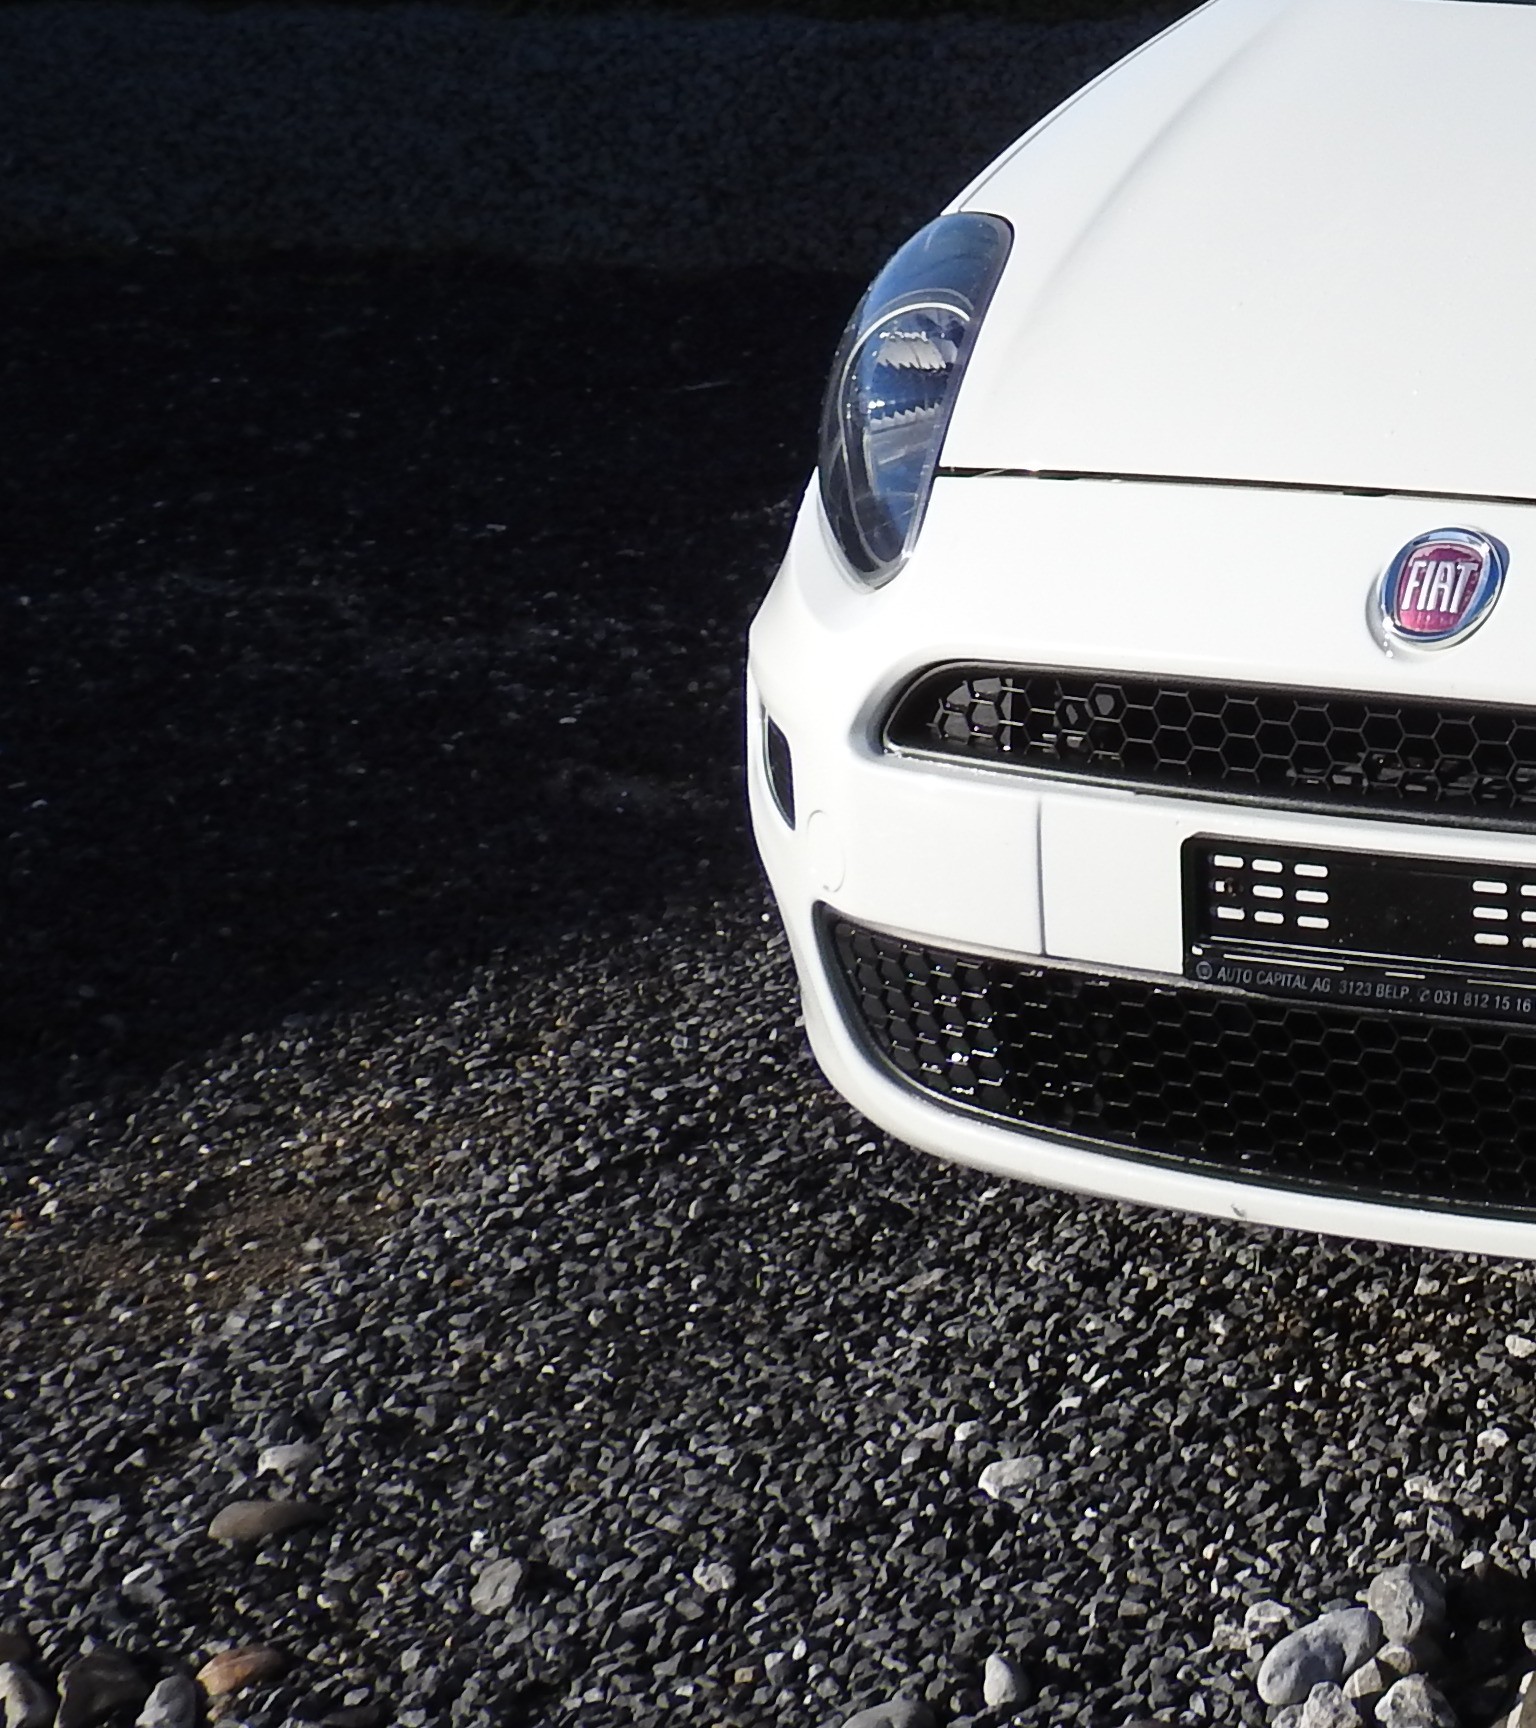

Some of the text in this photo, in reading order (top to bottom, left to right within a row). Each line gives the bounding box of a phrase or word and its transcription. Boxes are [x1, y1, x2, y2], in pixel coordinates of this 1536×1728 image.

[1401, 559, 1479, 614] FIAT
[1217, 966, 1250, 984] AUTO
[1256, 971, 1307, 990] CAPITAL
[1338, 980, 1372, 997] 3123
[1434, 989, 1458, 1005] 031
[1463, 992, 1489, 1009] 812
[1494, 995, 1511, 1011] 15
[1516, 997, 1532, 1013] 16
